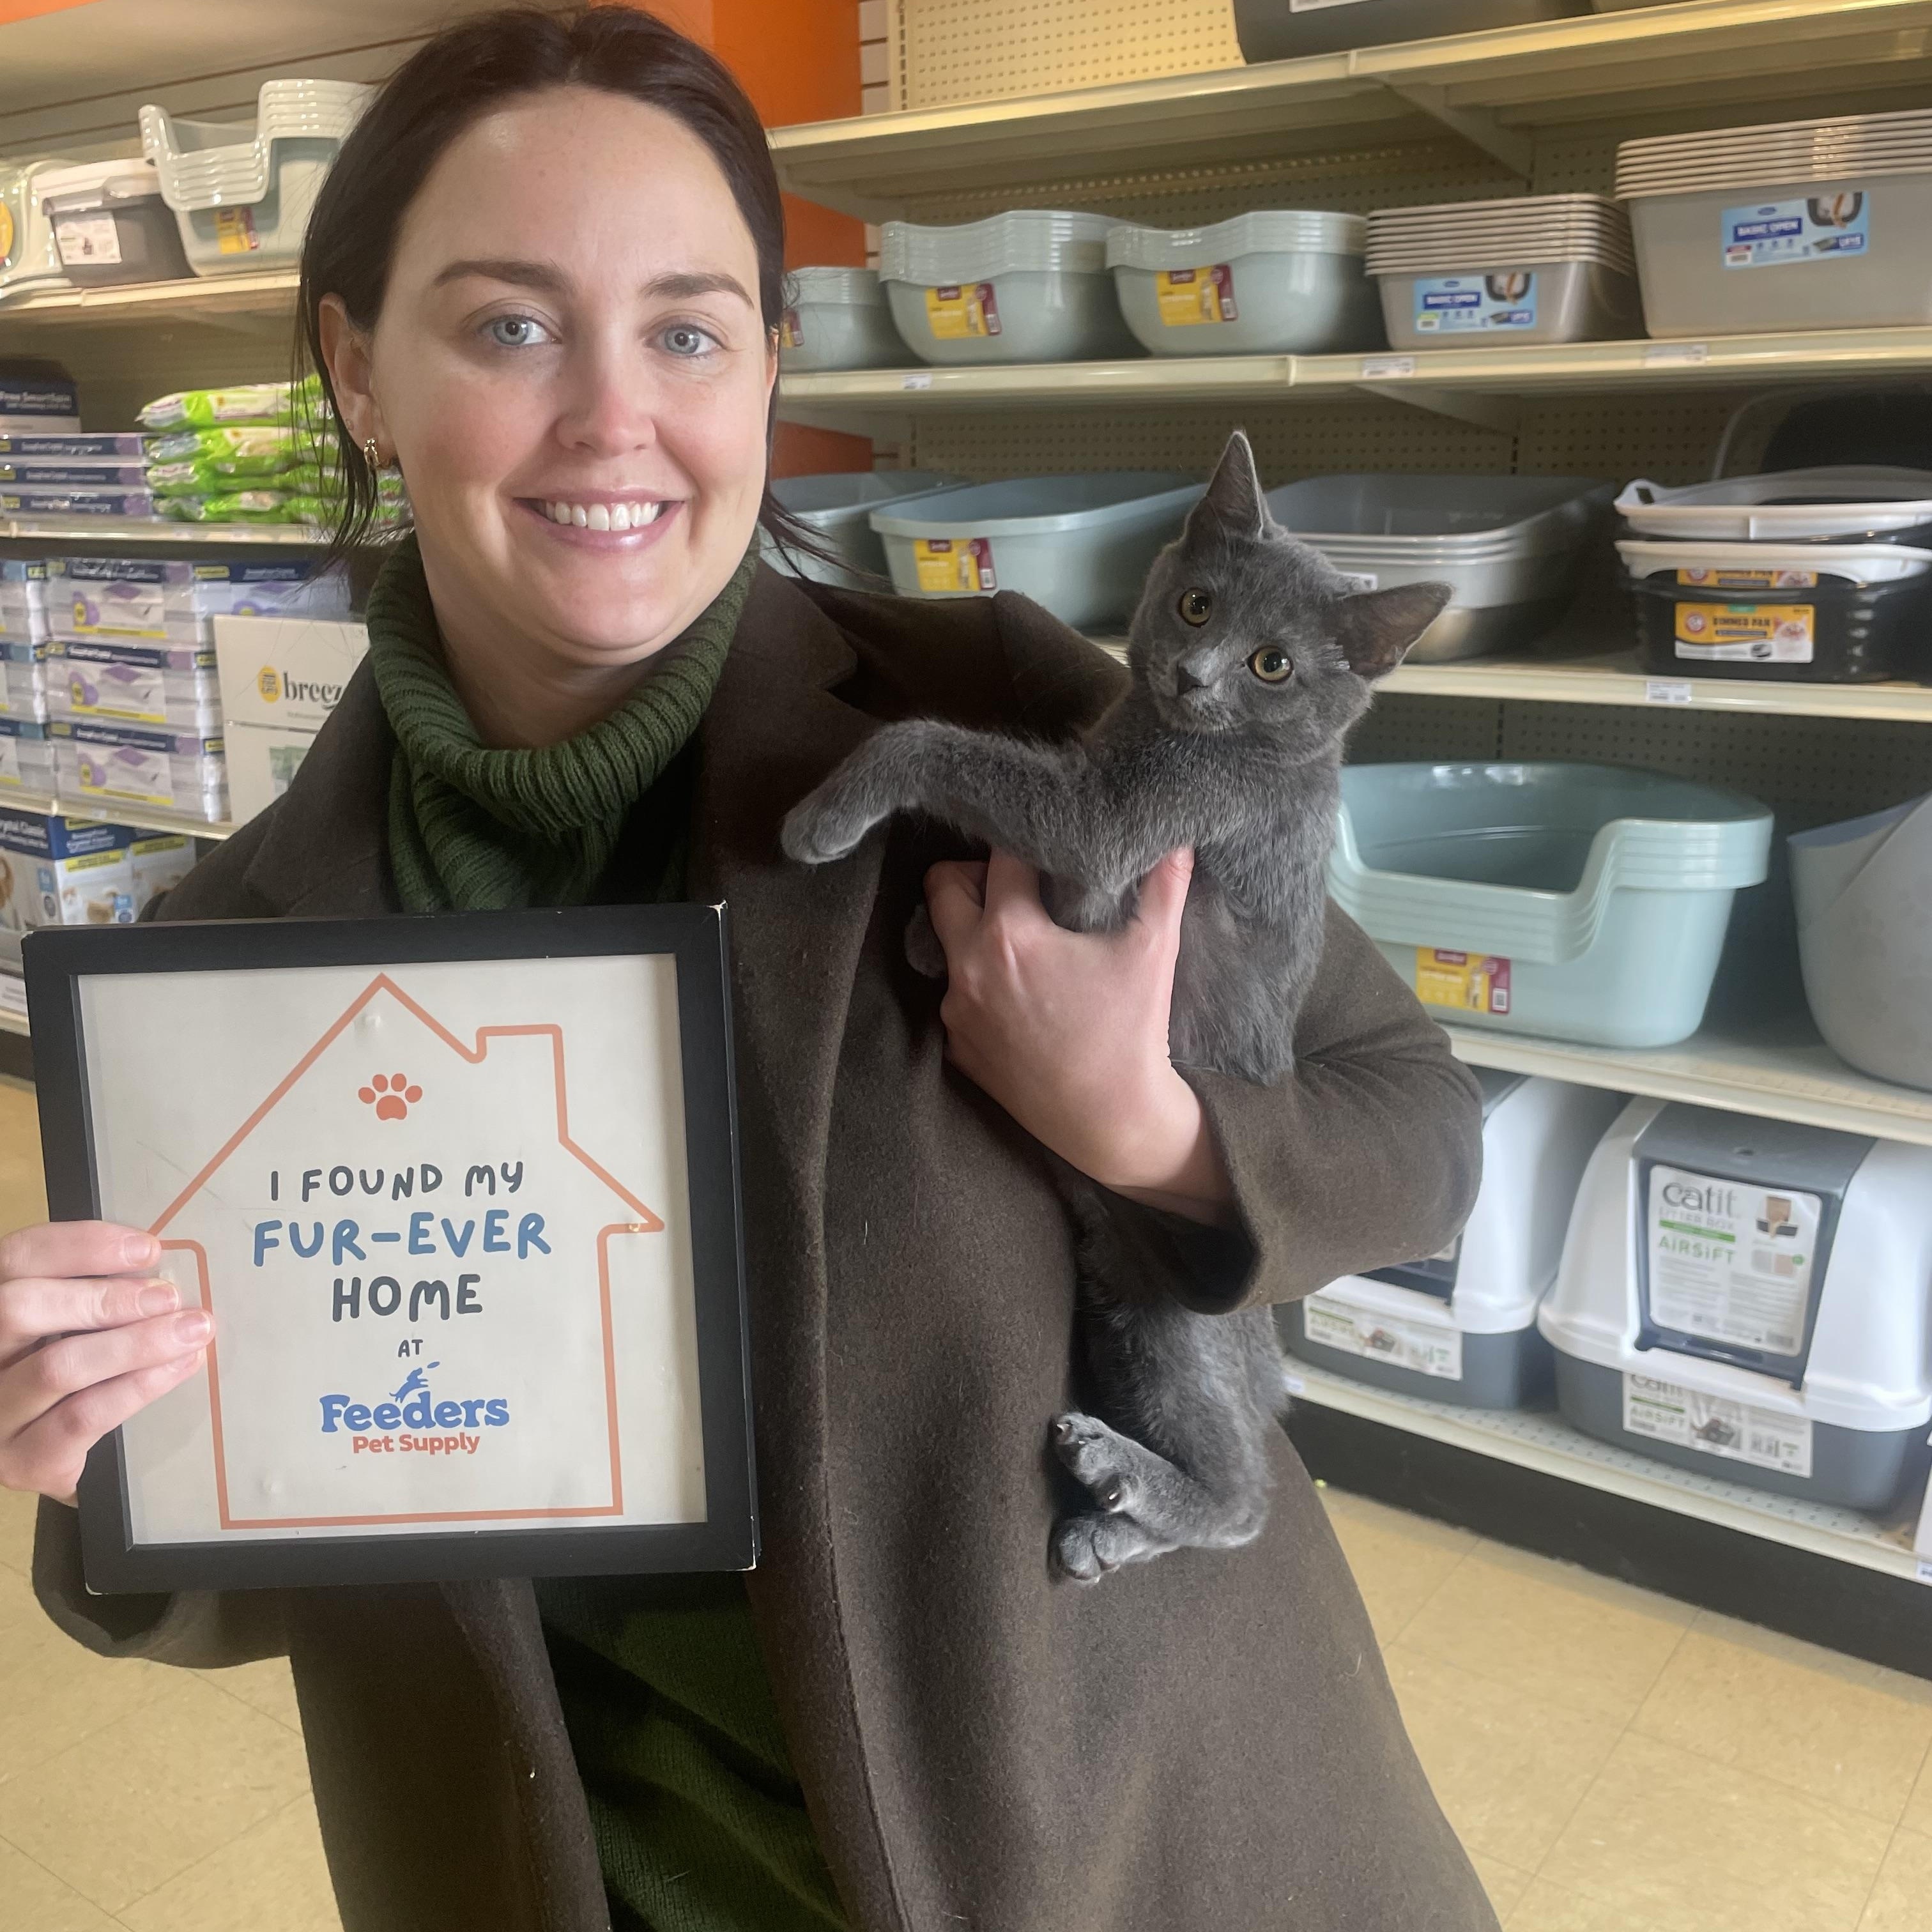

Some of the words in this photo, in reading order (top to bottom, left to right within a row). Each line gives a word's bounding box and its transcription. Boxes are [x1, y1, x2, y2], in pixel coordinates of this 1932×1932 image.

[271, 1170, 279, 1201] I
[302, 1163, 443, 1202] FOUND
[254, 1209, 551, 1267] FUR-EVER
[332, 1274, 483, 1322] HOME
[398, 1338, 424, 1358] AT
[319, 1391, 510, 1432] Feeders
[353, 1434, 394, 1453] Pet
[399, 1432, 480, 1455] Supply
